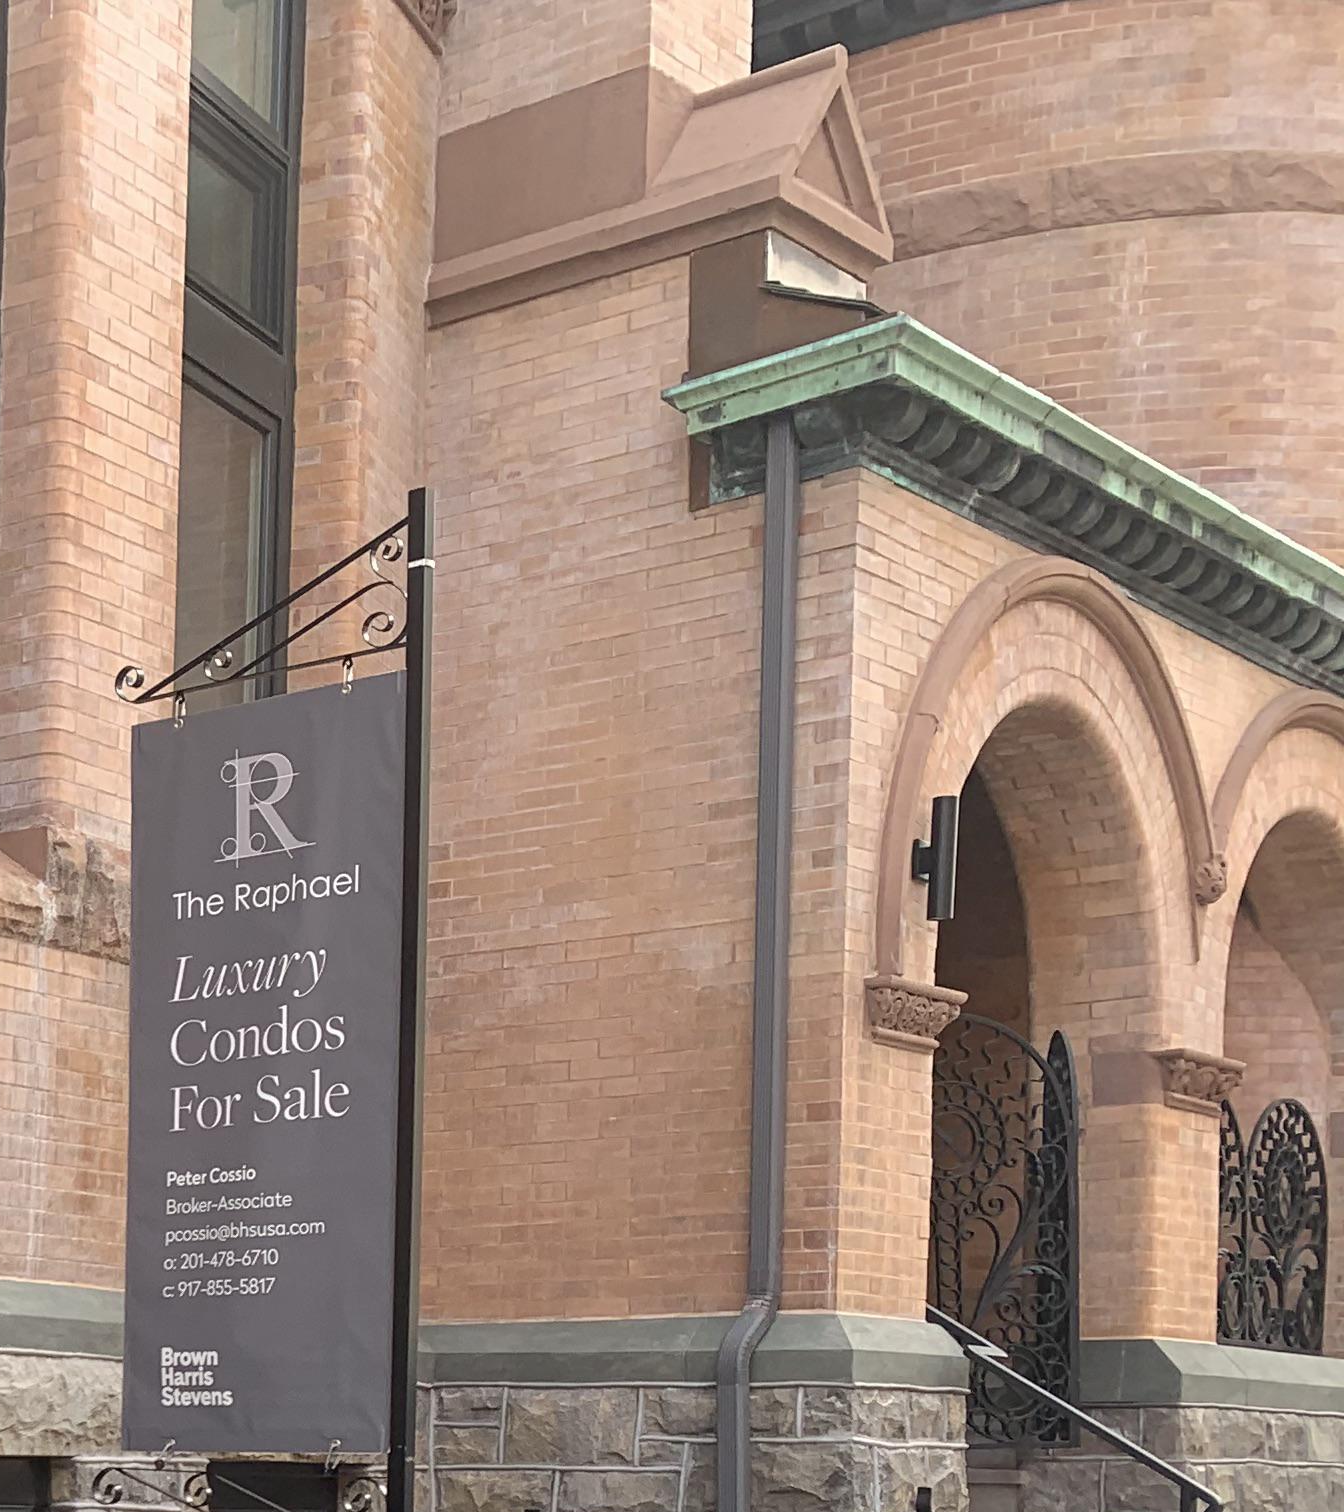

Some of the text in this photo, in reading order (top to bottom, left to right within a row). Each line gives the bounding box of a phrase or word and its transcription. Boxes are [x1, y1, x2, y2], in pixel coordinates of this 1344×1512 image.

[173, 864, 360, 920] The Raphael
[168, 949, 327, 1003] Luxury
[169, 1005, 346, 1067] Condos
[168, 1069, 350, 1133] For Sale
[166, 1164, 257, 1187] Peter Cossio
[165, 1192, 293, 1216] Broker-Associate
[164, 1220, 326, 1247] pcossio@bhsusa.com
[163, 1247, 280, 1271] o: 201-478-6710
[177, 1276, 277, 1298] 917-855-5817
[160, 1347, 219, 1367] Brown
[160, 1367, 215, 1387] Harris
[160, 1386, 234, 1407] Stevens
